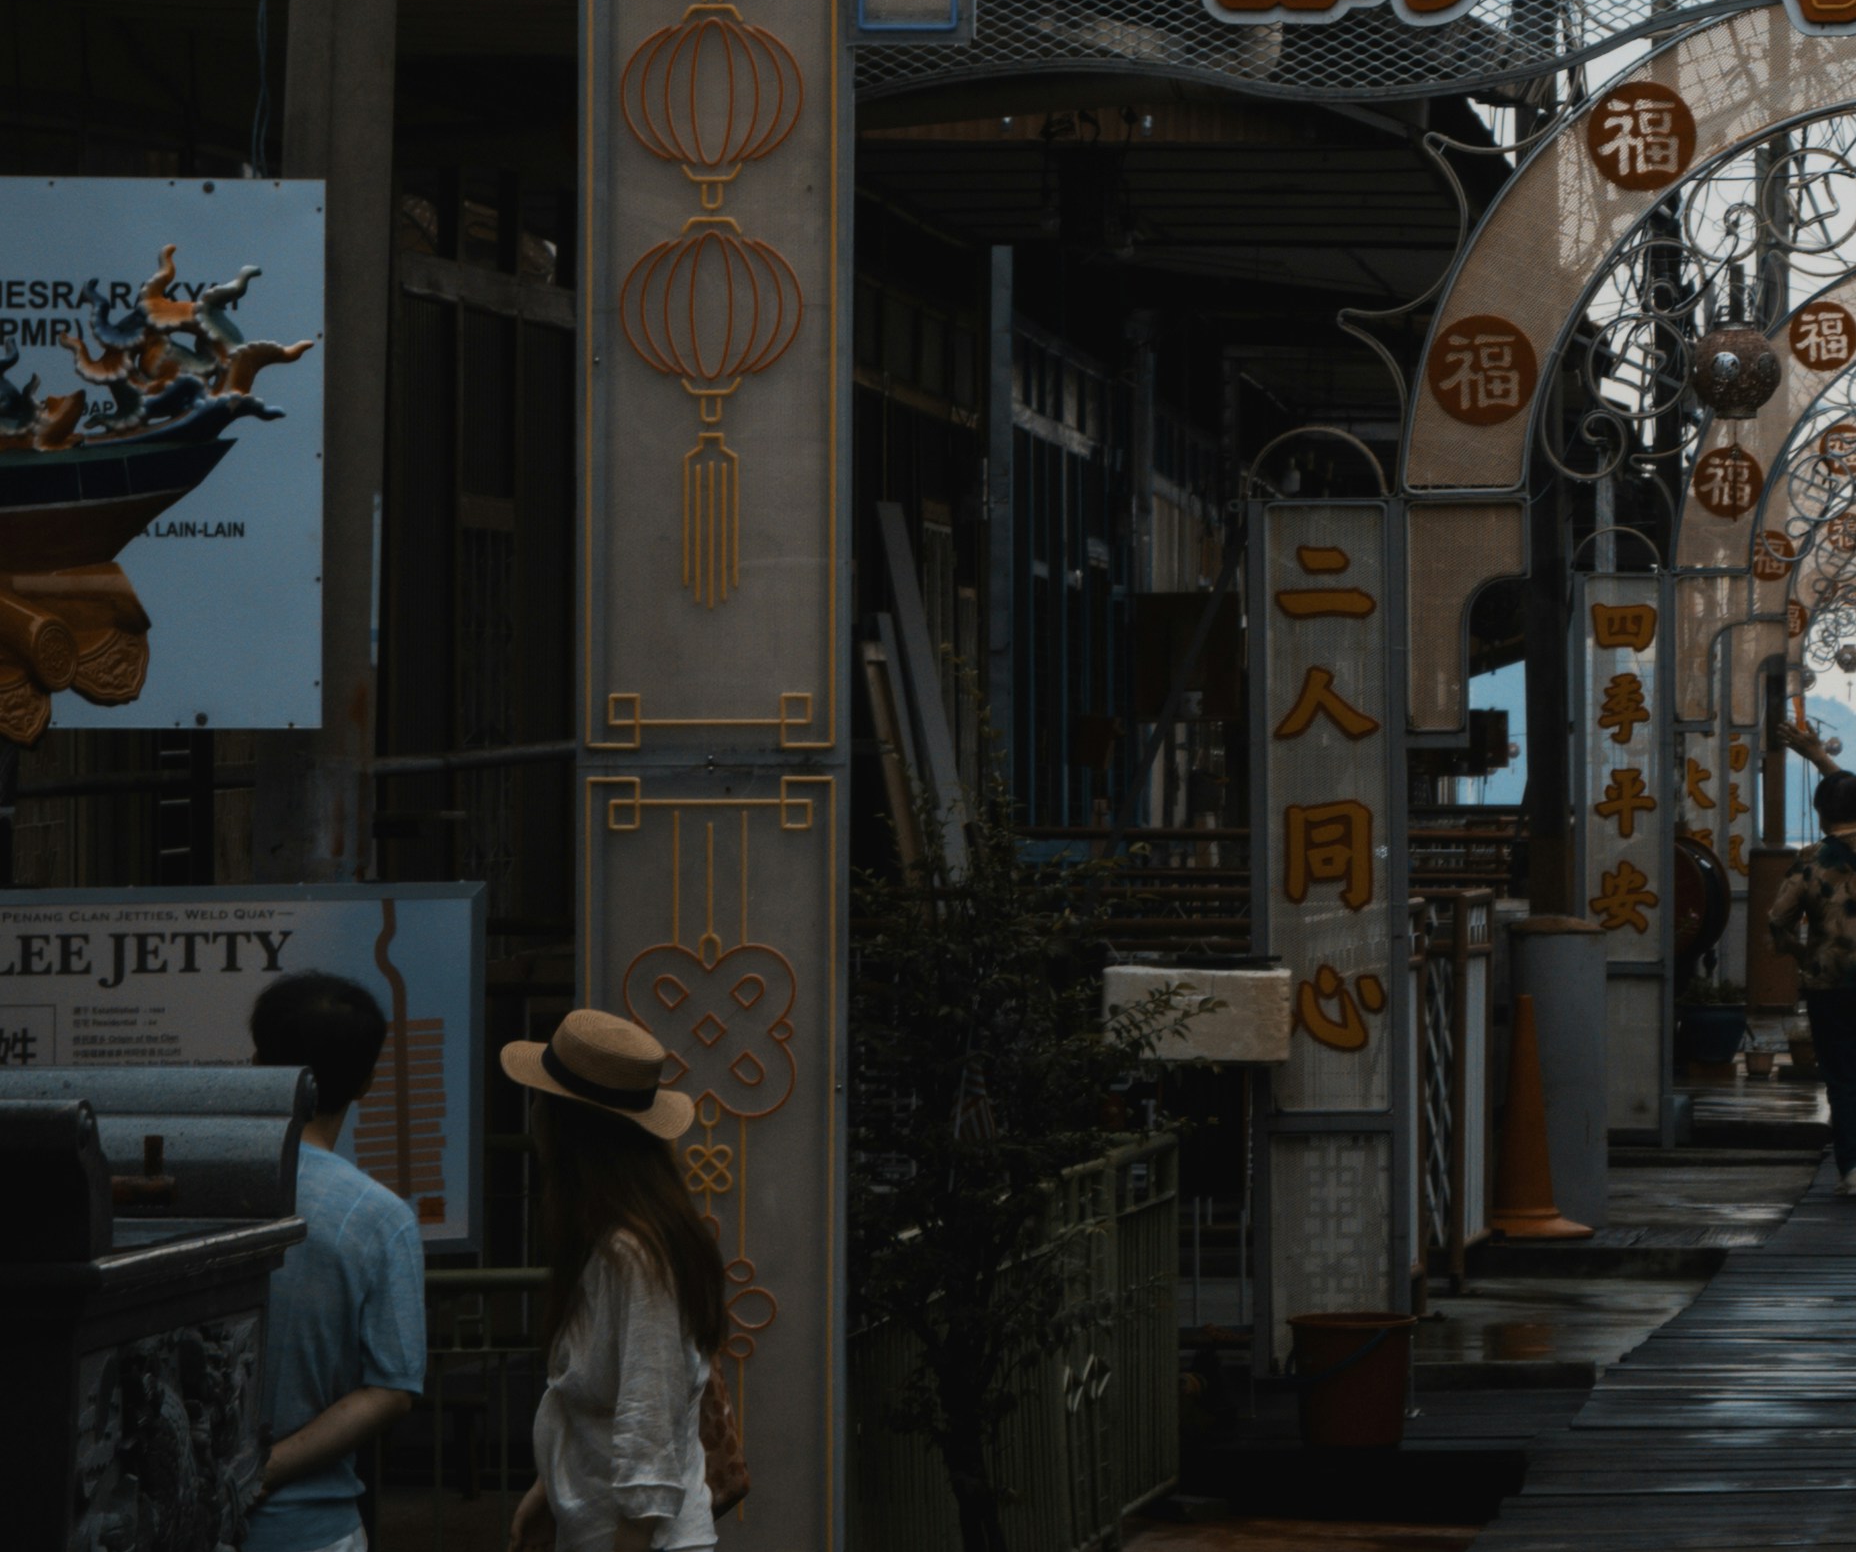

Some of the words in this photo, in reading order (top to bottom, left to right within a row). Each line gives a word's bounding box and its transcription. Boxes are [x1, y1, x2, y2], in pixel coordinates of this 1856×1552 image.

[1600, 97, 1679, 176] 福
[1796, 311, 1850, 363] 福
[1441, 333, 1523, 411] 福
[1698, 456, 1753, 508] 福
[155, 521, 245, 538] LAIN-LAIN
[1274, 545, 1387, 1052] 二人同心
[1590, 603, 1659, 935] 四季平安
[98, 930, 293, 989] JETTY
